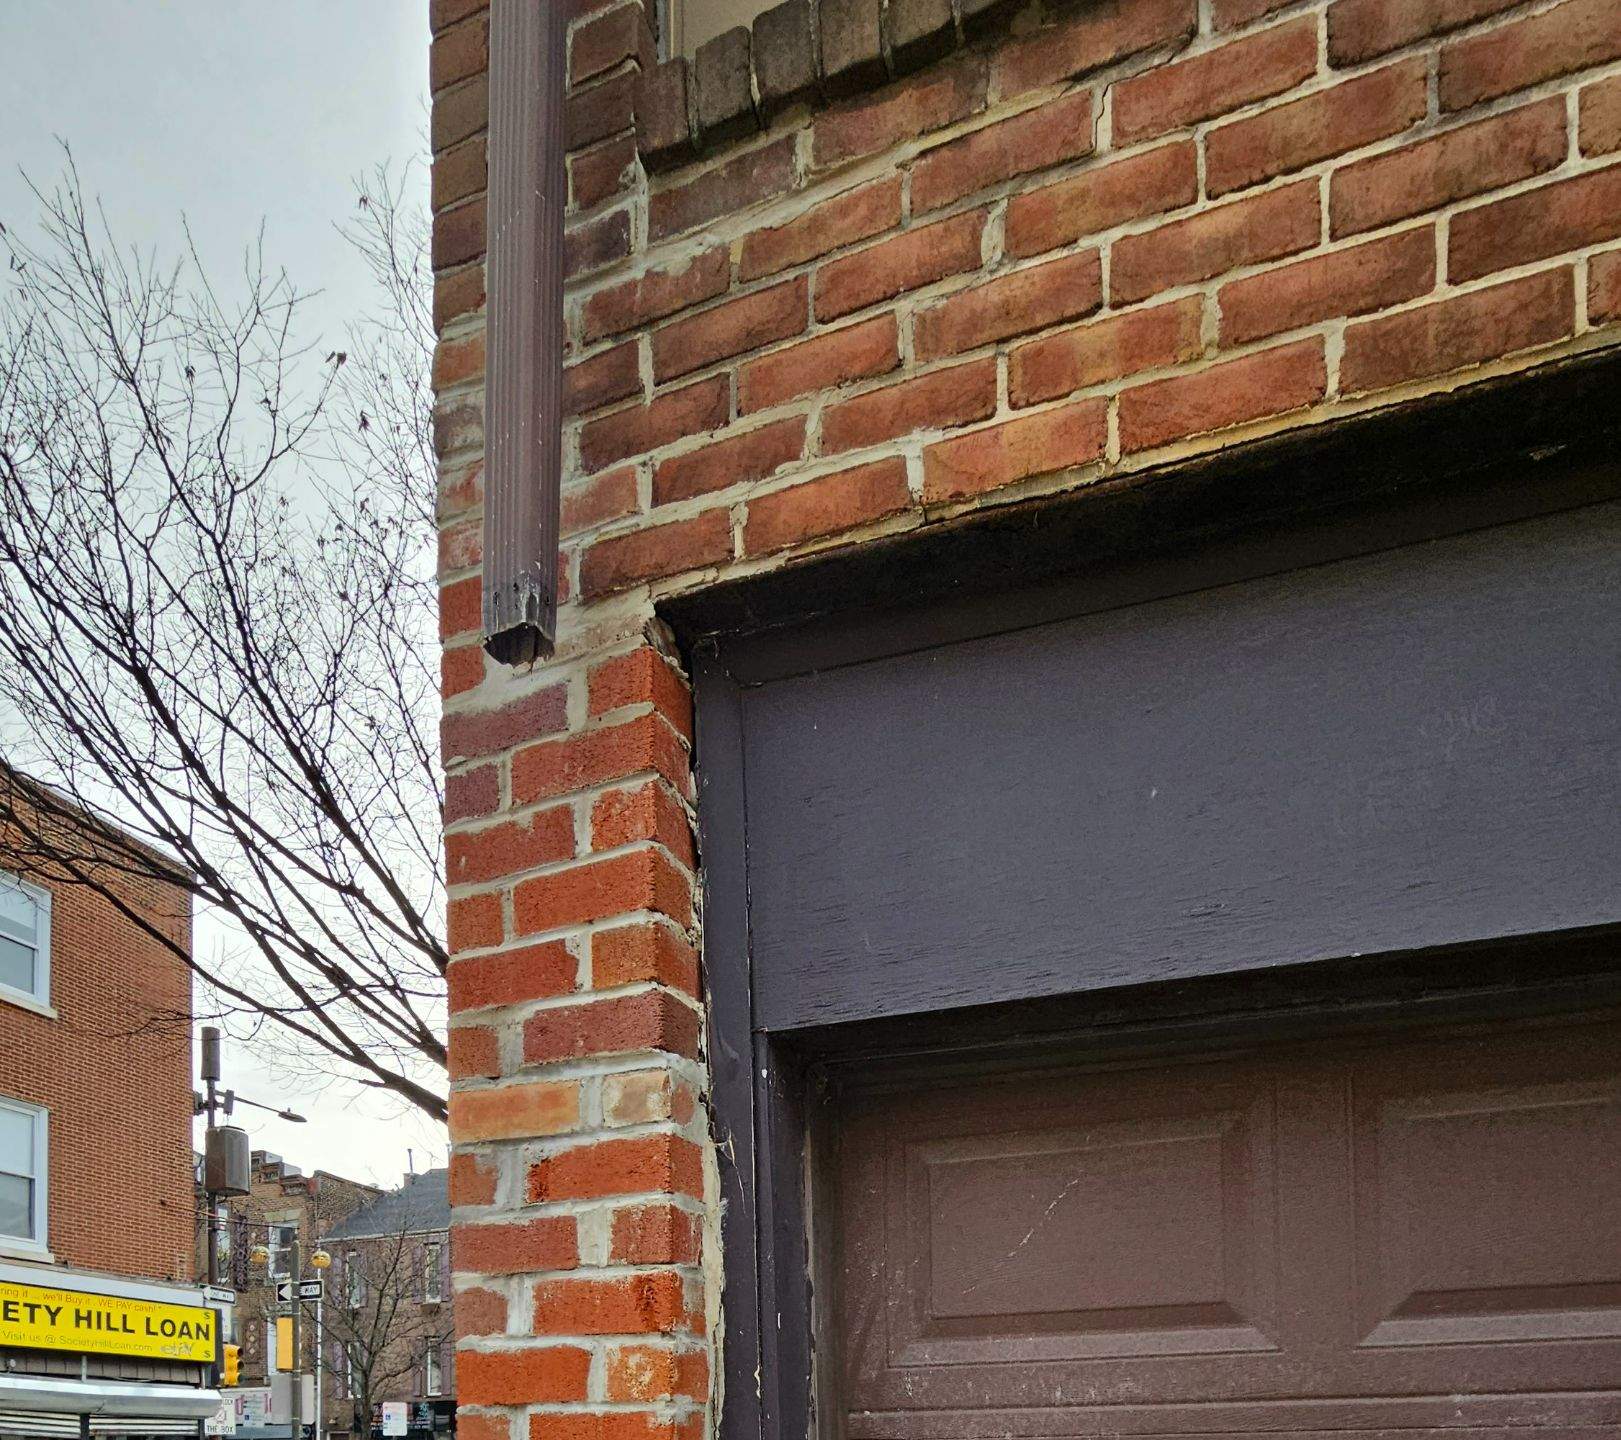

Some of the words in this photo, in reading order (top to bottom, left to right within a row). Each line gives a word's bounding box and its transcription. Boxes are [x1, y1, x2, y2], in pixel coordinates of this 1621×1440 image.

[99, 1298, 114, 1308] WE
[116, 1300, 132, 1310] PAY
[74, 1308, 135, 1334] HILL
[146, 1316, 210, 1341] LOAN
[3, 1330, 25, 1341] Visit
[207, 1424, 218, 1433] THE
[220, 1425, 234, 1434] BOX
